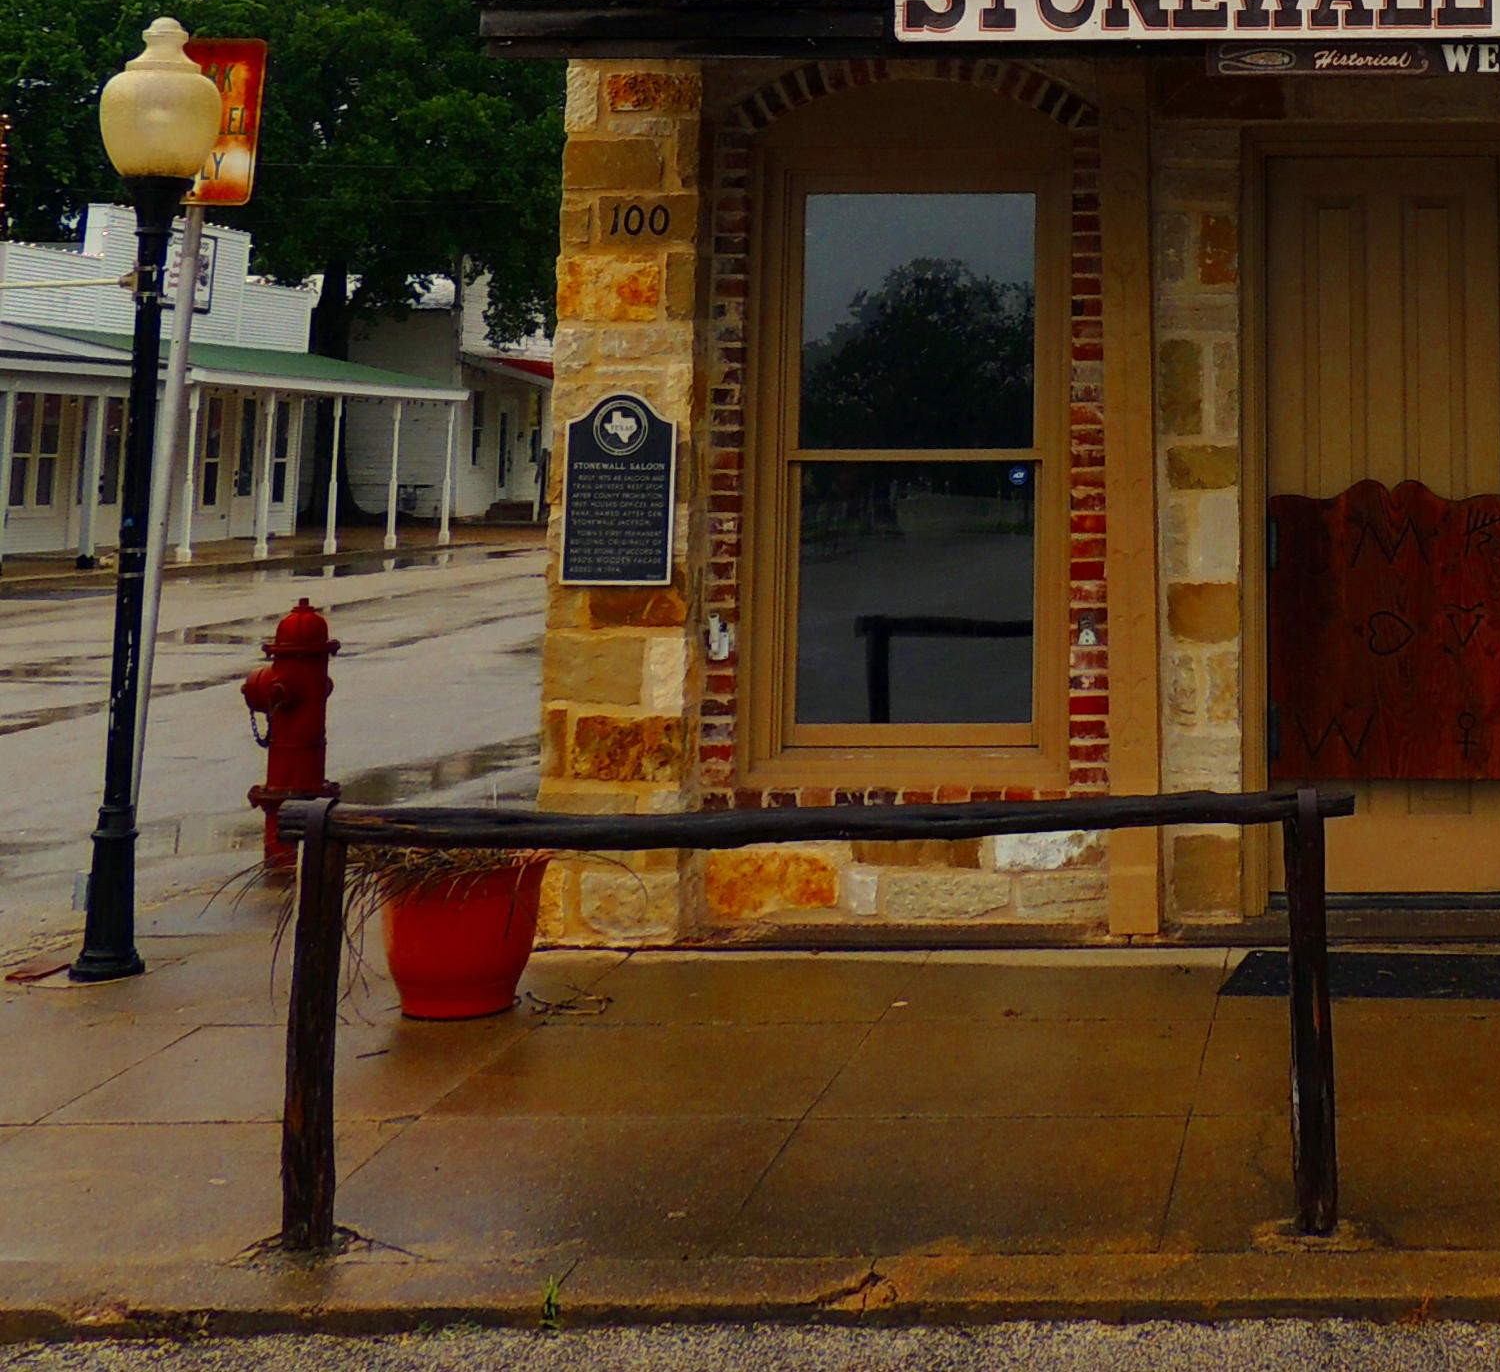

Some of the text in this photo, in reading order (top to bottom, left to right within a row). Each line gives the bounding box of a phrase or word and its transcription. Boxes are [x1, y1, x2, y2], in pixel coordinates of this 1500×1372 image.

[1313, 49, 1413, 69] Historical
[208, 64, 235, 92] RK
[219, 108, 250, 135] EL
[200, 152, 226, 180] LY
[610, 204, 669, 236] 100
[573, 462, 665, 470] STONEWALL SALOON
